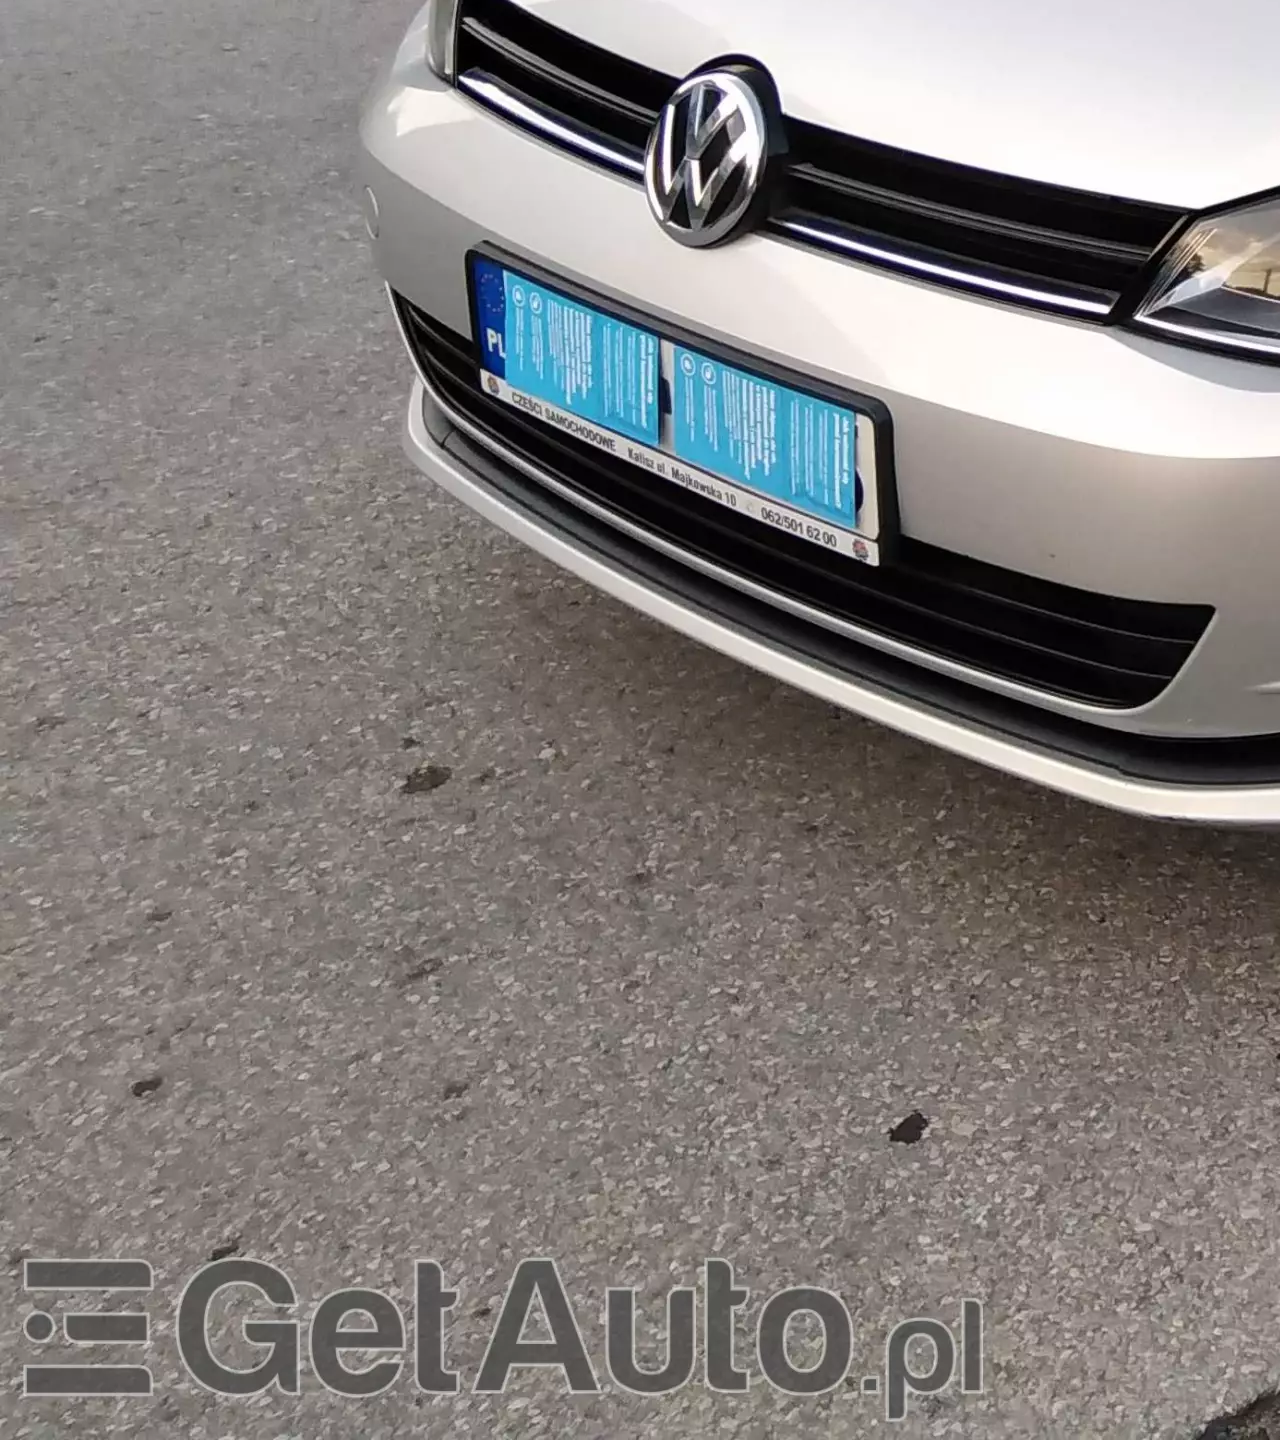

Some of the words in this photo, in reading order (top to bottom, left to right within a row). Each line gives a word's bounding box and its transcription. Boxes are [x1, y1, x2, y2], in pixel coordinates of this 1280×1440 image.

[485, 326, 505, 359] PL
[544, 408, 616, 452] SAMOCHODOWE
[725, 491, 737, 507] 10
[760, 507, 804, 534] 062/501
[806, 525, 821, 542] 62
[822, 531, 837, 548] 00
